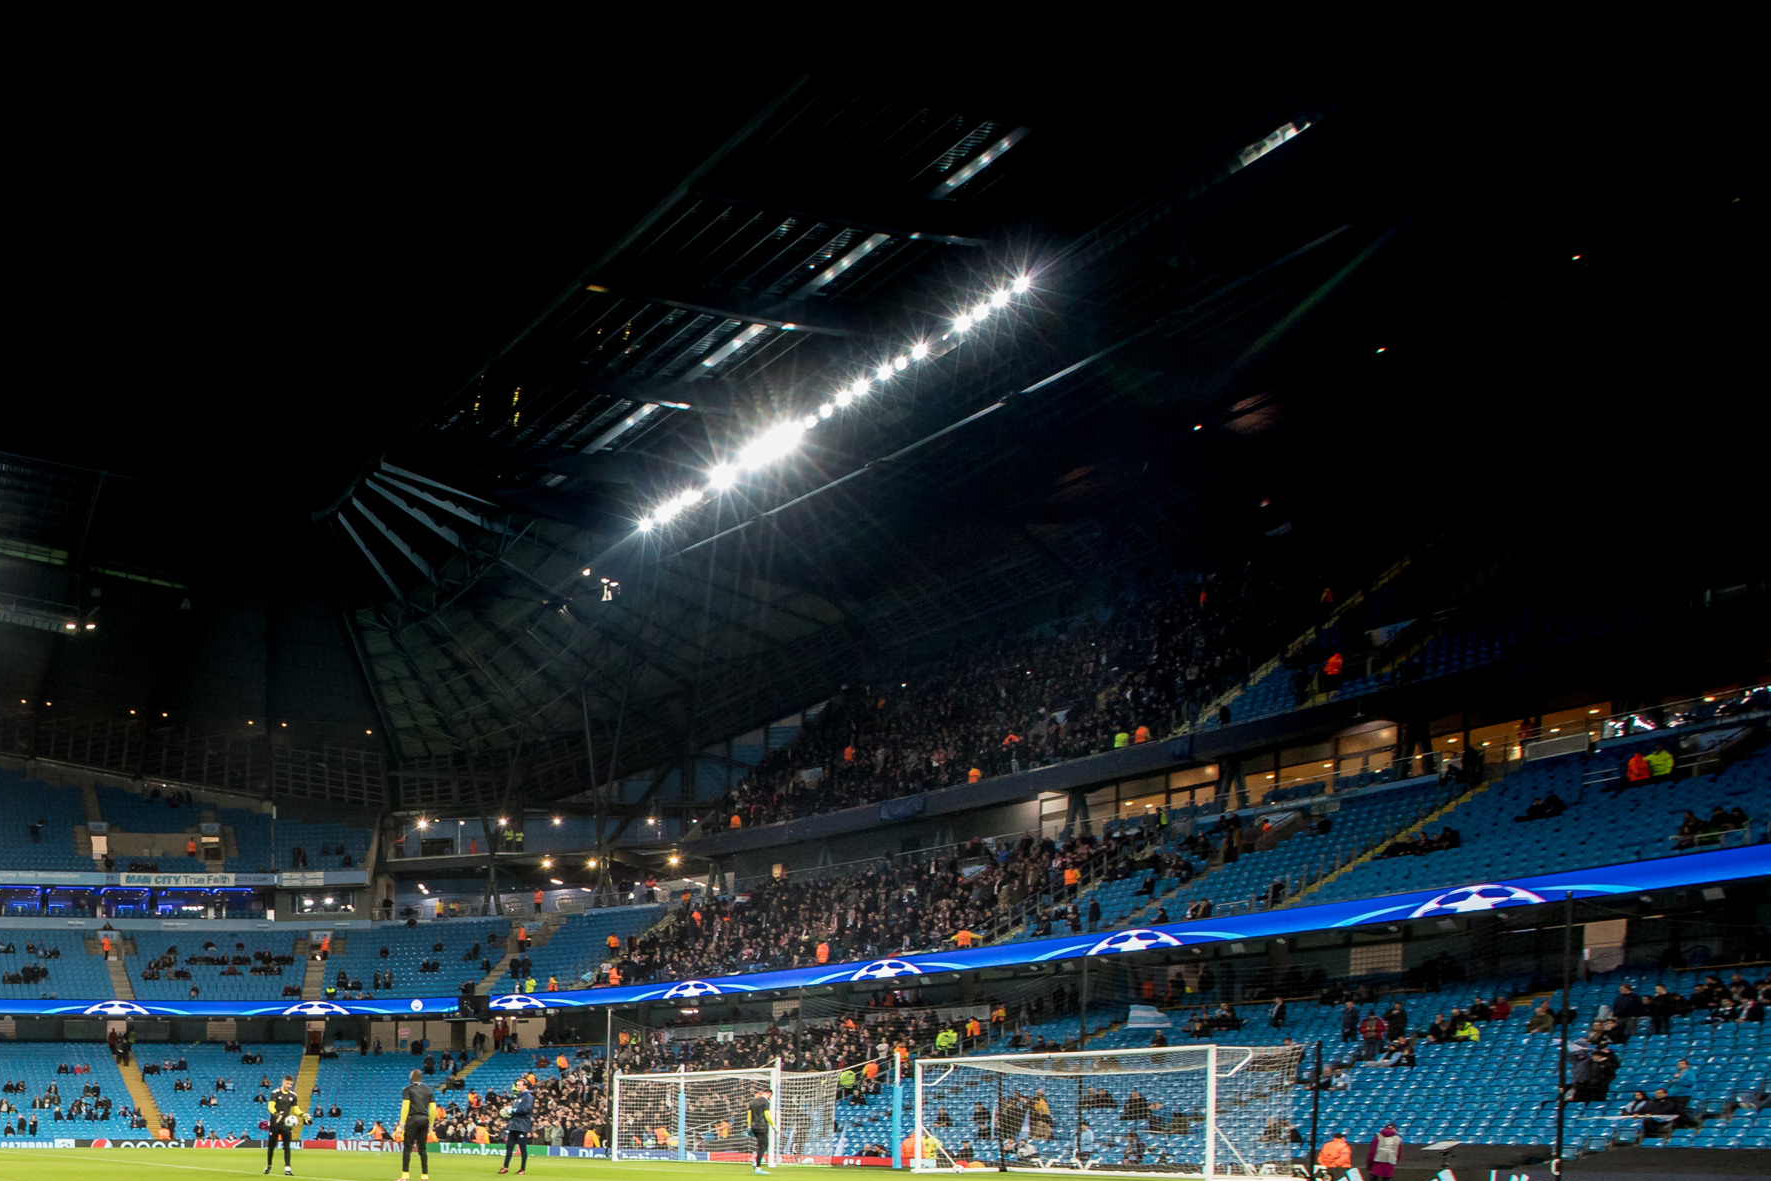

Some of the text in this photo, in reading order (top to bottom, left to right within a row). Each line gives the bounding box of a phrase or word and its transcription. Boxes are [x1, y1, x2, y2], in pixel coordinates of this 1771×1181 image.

[125, 875, 230, 884] MAN CITY True Faith
[336, 1140, 404, 1152] NISSAN
